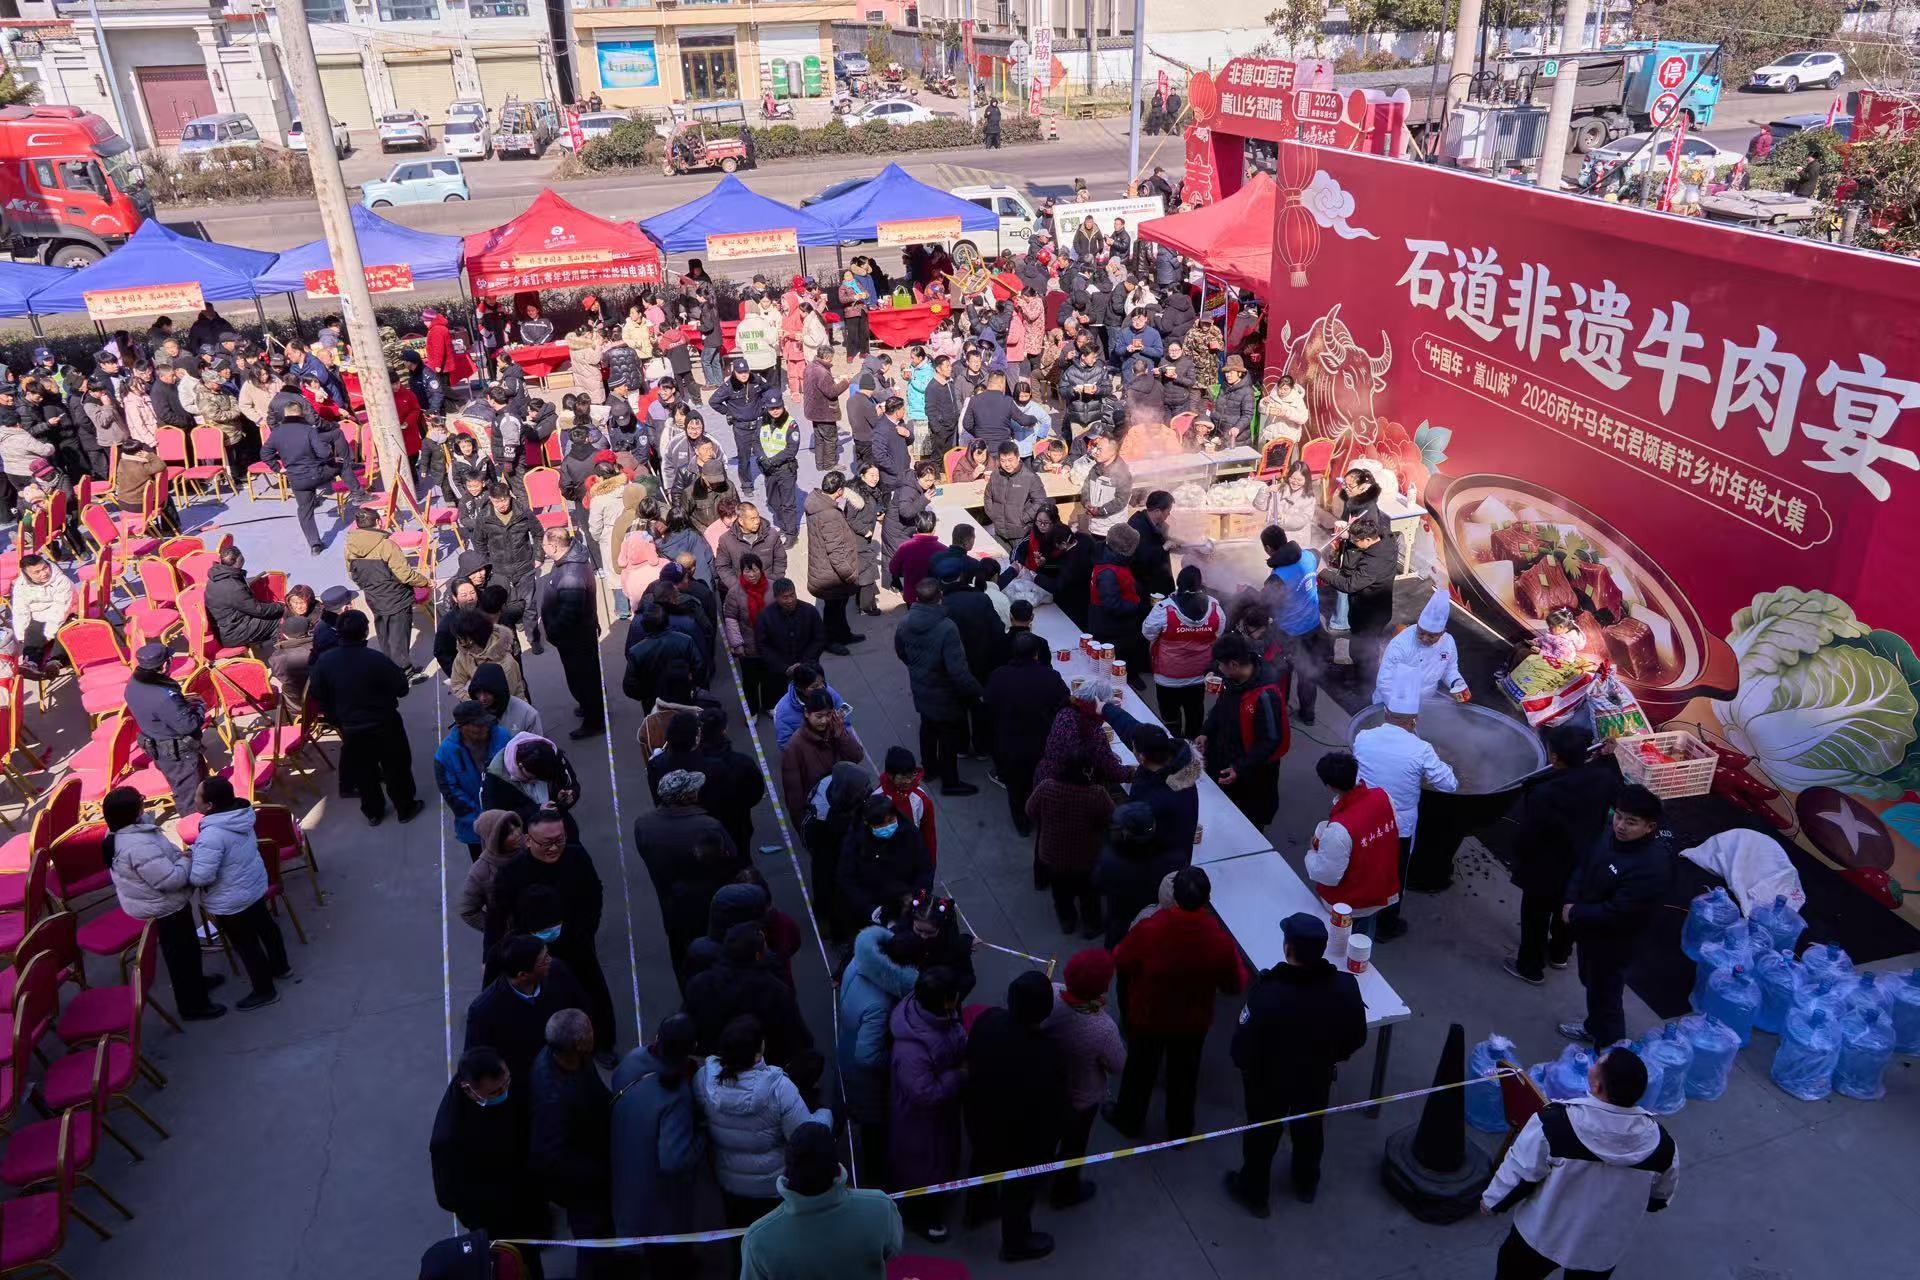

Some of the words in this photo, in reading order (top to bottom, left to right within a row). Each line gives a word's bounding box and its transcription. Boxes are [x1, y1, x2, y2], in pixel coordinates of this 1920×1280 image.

[1034, 28, 1050, 60] 钢筋
[1228, 63, 1294, 89] 非遗中国年
[1663, 61, 1682, 84] 停
[1221, 92, 1283, 121] 嵩山乡愁味
[1314, 94, 1336, 108] 2026
[1396, 237, 1920, 502] 石道非遗牛肉宴
